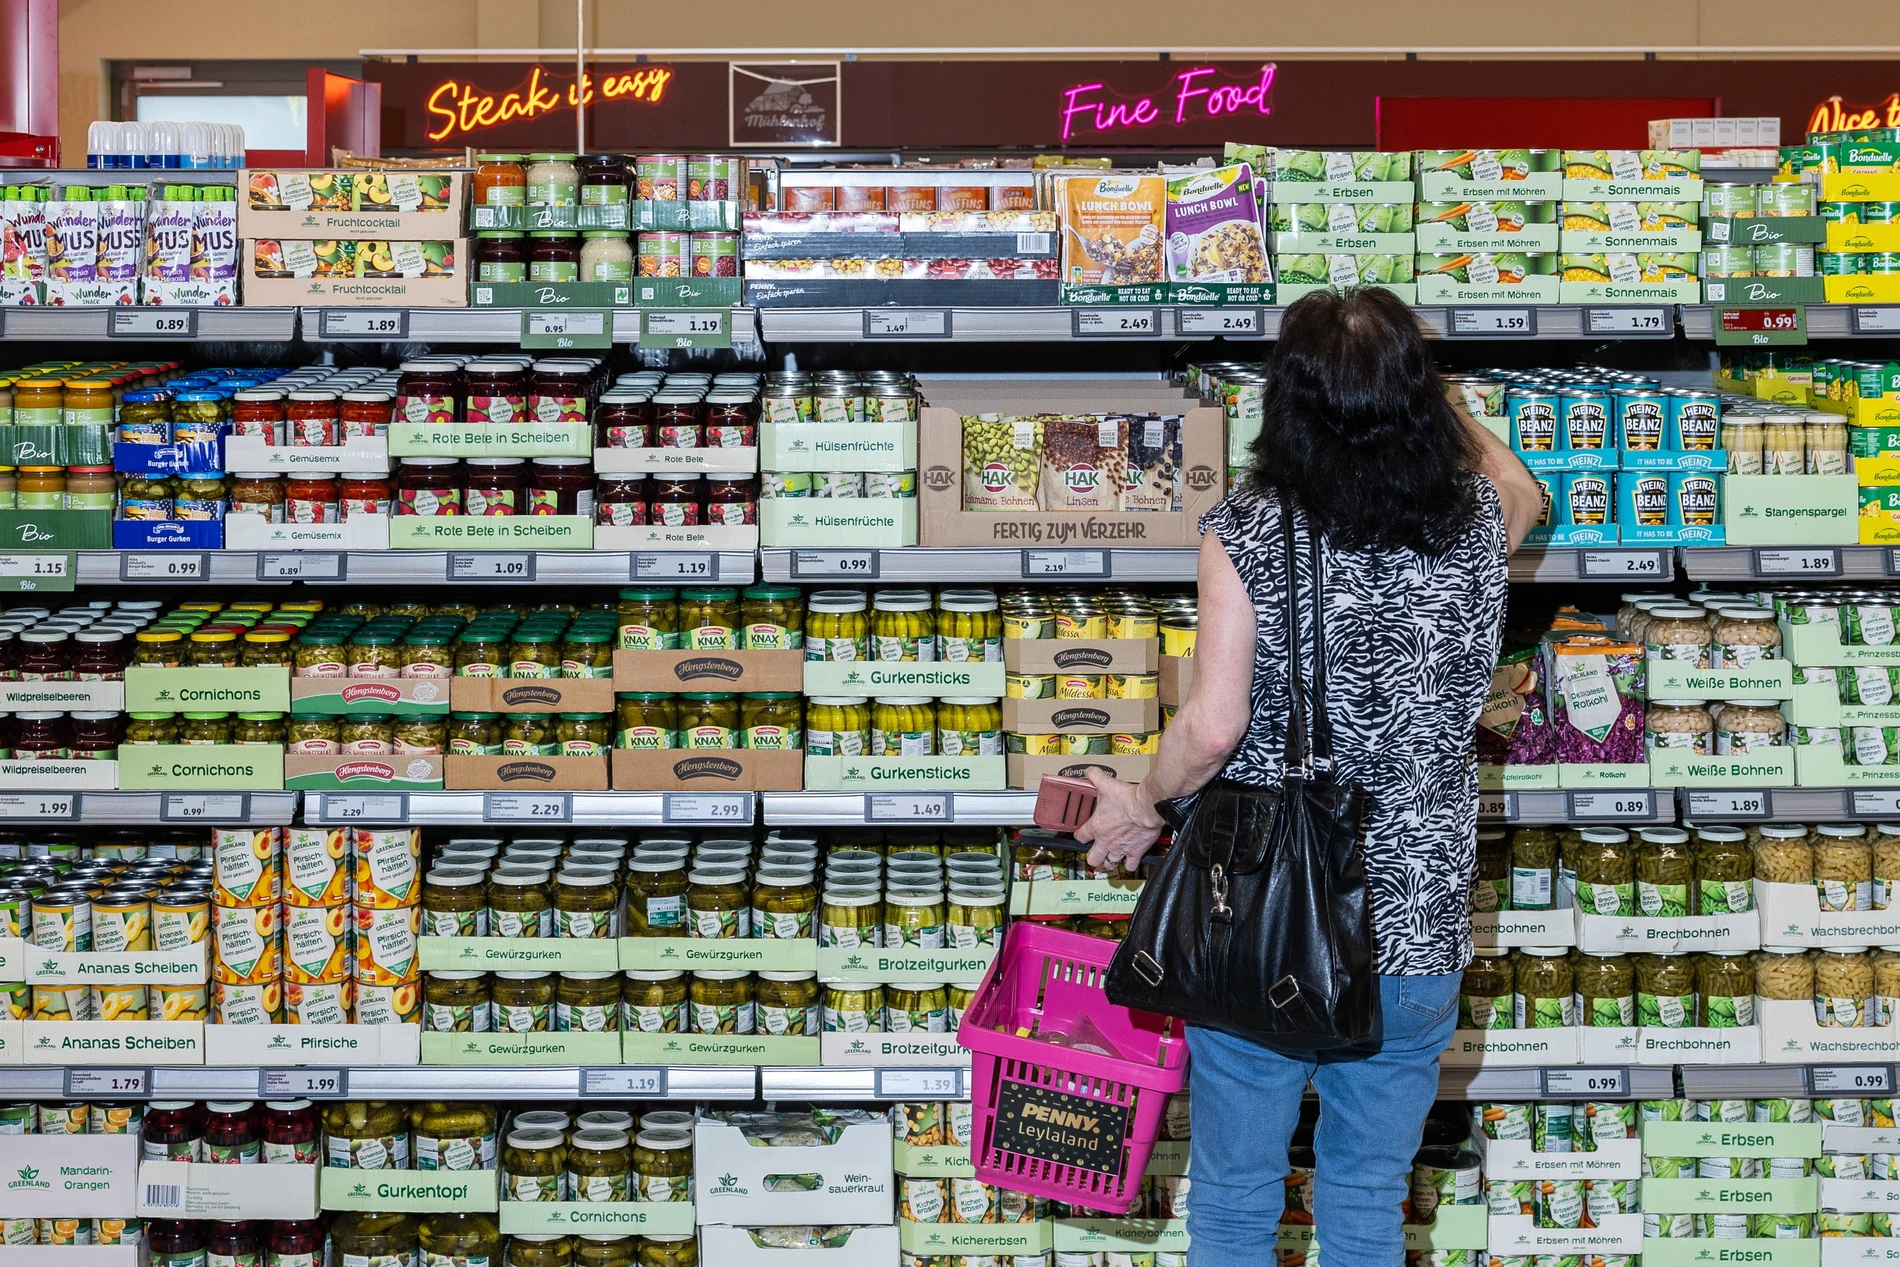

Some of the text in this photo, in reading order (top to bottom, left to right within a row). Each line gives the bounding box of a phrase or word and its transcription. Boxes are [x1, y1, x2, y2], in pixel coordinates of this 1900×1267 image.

[427, 67, 559, 142] Steak
[602, 68, 672, 103] easy
[1062, 66, 1277, 142] Fine Food
[745, 112, 826, 132] Mühlenhof
[1811, 99, 1881, 133] Nice
[1848, 149, 1893, 163] Bonduelle
[1099, 181, 1134, 195] Bonduelle
[1237, 183, 1250, 192] NEW
[1333, 187, 1374, 198] Erbsen
[1463, 187, 1546, 196] Erbsen mit Möhren
[1608, 184, 1681, 195] Sonnenmais
[1841, 187, 1871, 197] Bonduelle
[1081, 201, 1153, 212] LUNCH BOWL
[1174, 197, 1239, 218] LUNCH BOWL
[326, 217, 400, 229] Fruchtcocktail
[532, 211, 567, 228] Bio
[1747, 224, 1783, 241] Bio
[71, 286, 112, 300] Wunder
[756, 287, 805, 301] Einfach sparen
[1177, 287, 1220, 302] Bonduelle
[1605, 287, 1678, 298] Sonnenmais
[1744, 284, 1781, 301] Bio
[156, 318, 184, 330] 0.89
[367, 320, 396, 331] 1.89
[689, 320, 718, 332] 1.19
[1120, 319, 1149, 329] 2.49
[1223, 318, 1252, 329] 2.49
[1495, 318, 1524, 329] 1.59
[1631, 317, 1660, 328] 1.79
[1763, 316, 1792, 328] 0.99
[545, 325, 564, 333] 0.95
[1523, 405, 1550, 416] HEINZ
[1520, 419, 1554, 432] BEANZ
[432, 431, 570, 444] Rote Bete in Scheiben
[14, 441, 51, 460] Bio
[815, 440, 895, 454] Hülsenfrüchte
[289, 453, 340, 464] Gemüsemix
[664, 455, 704, 464] Rote Bete
[1556, 458, 1564, 466] BE
[1571, 455, 1600, 467] HEINZ
[924, 470, 955, 486] HAK
[1065, 470, 1100, 485] HAK
[1186, 470, 1218, 486] HAK
[1685, 481, 1712, 492] HEINZ
[1001, 496, 1036, 506] Bohnen
[1066, 496, 1099, 506] Linsen
[1133, 495, 1167, 505] Bohnen
[1682, 495, 1716, 507] BEANZ
[1765, 507, 1848, 518] Stangenspargel
[993, 517, 1147, 543] FERTIG ZUM VERZEHR
[147, 534, 191, 544] Burger Gurken
[34, 562, 62, 574] 1.15
[168, 562, 196, 574] 0.99
[495, 562, 523, 574] 1.09
[678, 562, 706, 573] 1.19
[840, 560, 867, 570] 0.99
[1045, 564, 1064, 572] 2.19
[1627, 560, 1655, 571] 2.49
[1802, 558, 1830, 569] 1.89
[279, 567, 298, 575] 0.89
[20, 579, 36, 591] Bio
[623, 634, 651, 645] KNAX
[1868, 630, 1890, 638] bohnen
[678, 661, 740, 676] Hengstenberg
[870, 670, 971, 686] Gurkensticks
[1686, 677, 1782, 689] Weiße Bohnen
[6, 692, 91, 703] Wildpreiselbeeren
[180, 688, 261, 701] Cornichons
[345, 685, 398, 699] Hengstenberg
[1060, 686, 1095, 700] Mildessa
[1570, 686, 1605, 700] Delikatess
[1573, 694, 1609, 710] Rotkohl
[753, 735, 783, 747] KNAX
[172, 763, 254, 777] Cornichons
[500, 765, 553, 778] Hengstenberg
[677, 759, 738, 774] Hengstenberg
[1501, 773, 1543, 782] Apfelrotkohl
[1599, 771, 1627, 779] Rotkohl
[39, 803, 67, 814] 1.99
[532, 804, 560, 815] 2.29
[711, 805, 739, 816] 2.99
[913, 804, 941, 815] 1.49
[1615, 801, 1643, 813] 0.89
[1731, 800, 1759, 812] 1.89
[342, 808, 361, 817] 2.29
[219, 841, 246, 851] GREENLAND
[220, 853, 250, 864] Pfirsich-
[223, 861, 250, 872] hälften
[1646, 927, 1730, 940] Brechbohnen
[485, 948, 562, 960] Gewürzgurken
[77, 962, 132, 974] Ananas
[135, 961, 198, 974] Scheiben
[878, 957, 987, 973] Brotzeitgurken
[301, 1036, 358, 1049] Pfirsiche
[111, 1078, 139, 1089] 1.79
[307, 1079, 335, 1090] 1.99
[627, 1078, 655, 1090] 1.19
[922, 1080, 950, 1091] 1.39
[1588, 1076, 1617, 1089] 0.99
[1855, 1075, 1883, 1087] 0.99
[1021, 1102, 1101, 1134] PENNY.
[1018, 1121, 1099, 1151] Leylaland
[60, 1165, 112, 1178] Mandarin-
[8, 1179, 50, 1189] GREENLAND
[844, 1174, 872, 1183] Wein-
[64, 1179, 110, 1192] Orangen
[709, 1187, 749, 1196] GREENLAND
[828, 1184, 884, 1194] sauerkraut
[377, 1184, 468, 1202] Gurkentopf
[570, 1210, 647, 1223] Cornichons
[951, 1234, 1028, 1246] Kichererbsen
[1115, 1228, 1185, 1240] Kidneybohnen
[1536, 1235, 1623, 1246] Erbsen mit Möhren
[1720, 1249, 1773, 1262] Erbsen
